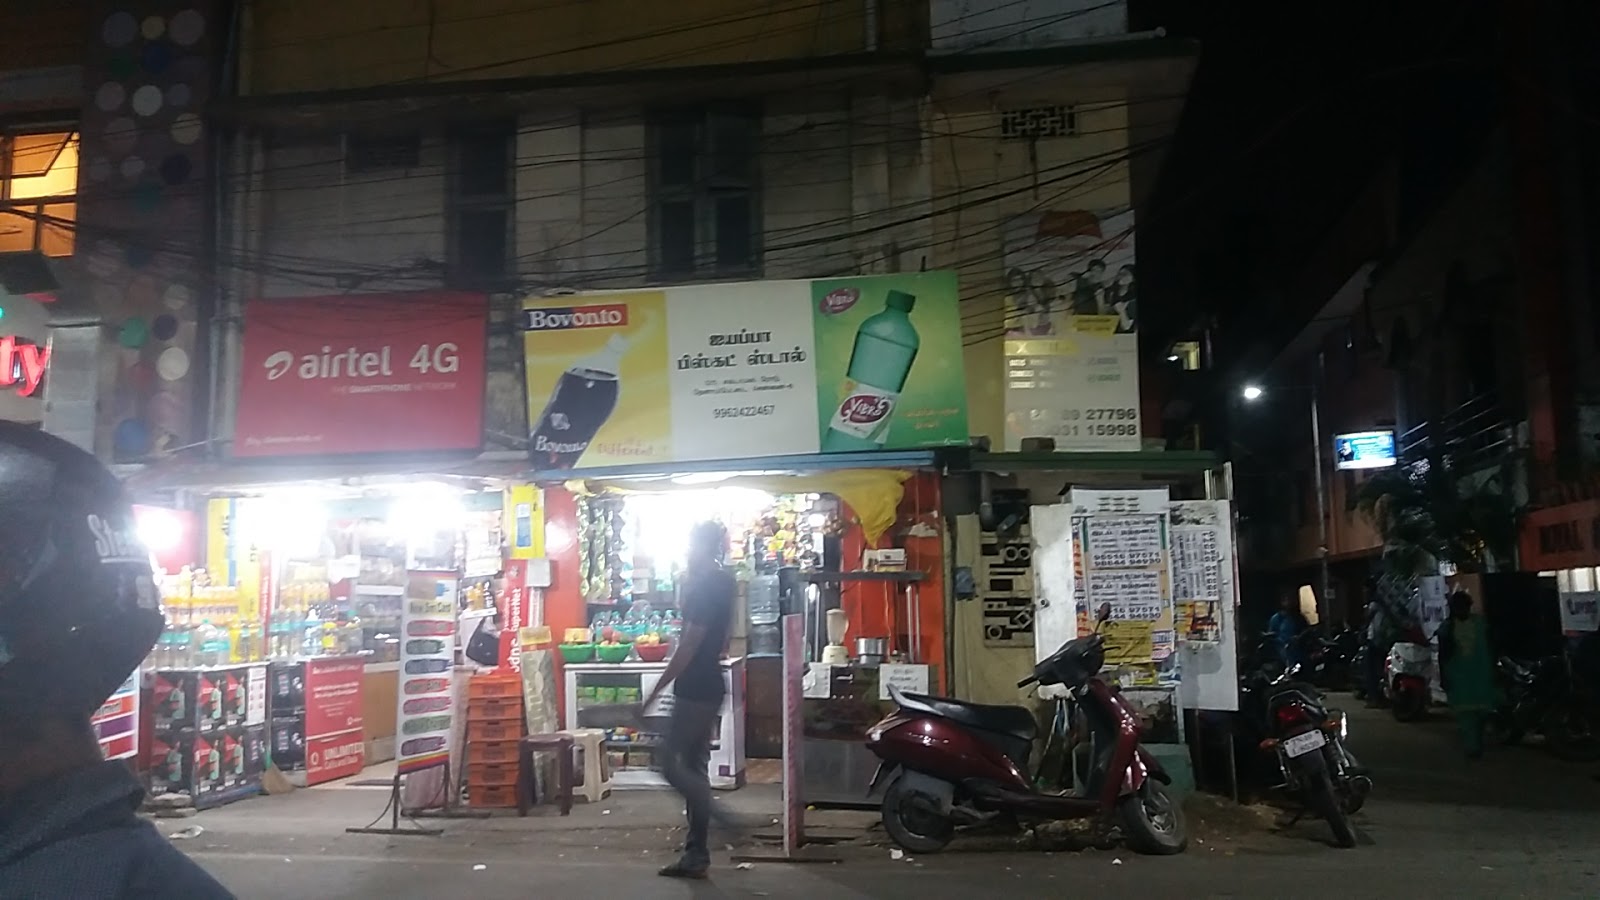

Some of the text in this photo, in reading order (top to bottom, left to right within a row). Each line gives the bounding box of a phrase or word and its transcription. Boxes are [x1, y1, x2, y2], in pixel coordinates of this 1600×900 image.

[528, 308, 623, 328] Bovonto
[298, 342, 460, 379] airtel 4G
[1086, 408, 1137, 421] 27796
